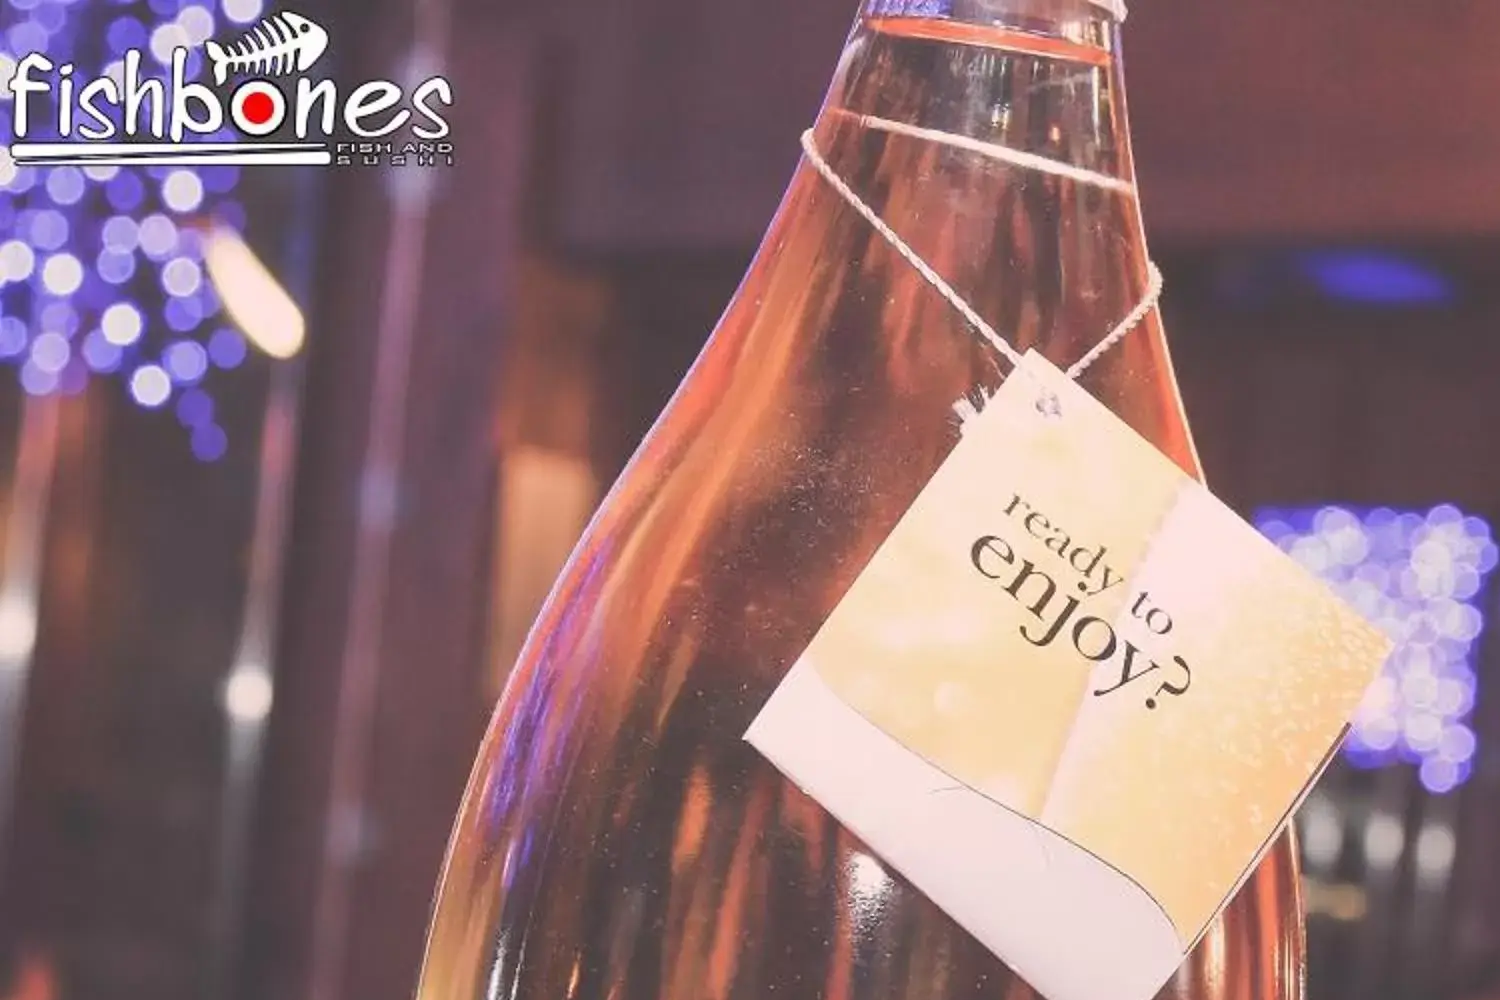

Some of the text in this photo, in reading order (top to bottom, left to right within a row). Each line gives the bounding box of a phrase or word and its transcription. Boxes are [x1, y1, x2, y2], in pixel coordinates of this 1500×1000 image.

[970, 534, 1191, 710] enjoy?
[1003, 492, 1173, 635] ready to
